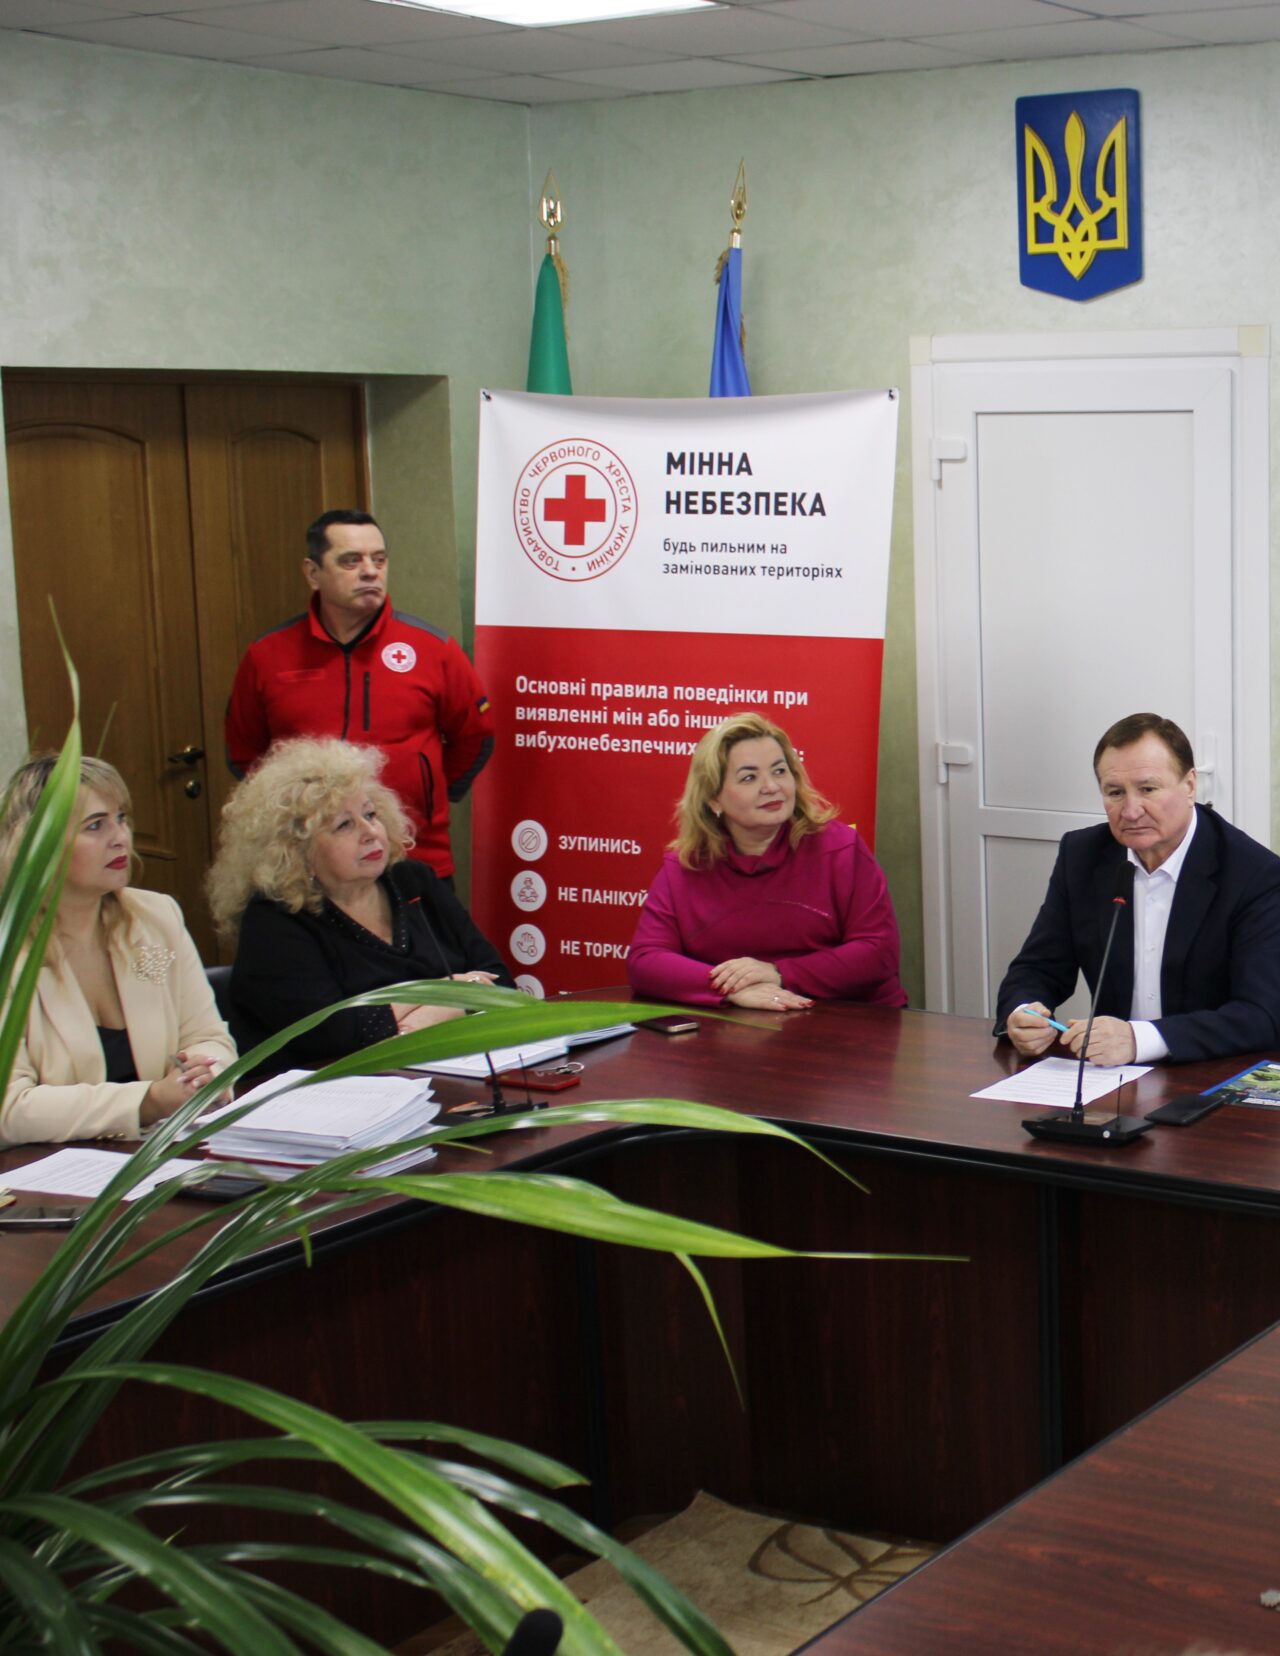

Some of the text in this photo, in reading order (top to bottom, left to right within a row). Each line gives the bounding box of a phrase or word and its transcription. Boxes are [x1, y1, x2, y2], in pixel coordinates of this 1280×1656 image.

[665, 451, 753, 476] МІННА
[519, 446, 631, 572] ТОВАРИСТВО ЧЕРВОНОГО ХРЕСТА УКРАЇНИ
[664, 491, 827, 517] НЕБЕЗПЕКА
[662, 538, 788, 555] будь пильним на
[662, 562, 844, 580] замінованих територіях
[515, 676, 809, 707] Основні правила поведінки при
[515, 705, 608, 725] виявленні
[613, 707, 643, 726] мін
[647, 709, 680, 728] або
[515, 731, 697, 756] вибухонебезпечних
[558, 835, 642, 855] ЗУПИНИСЬ
[558, 887, 648, 907] НЕ ПАНІКУЙ
[560, 940, 580, 956] НЕ
